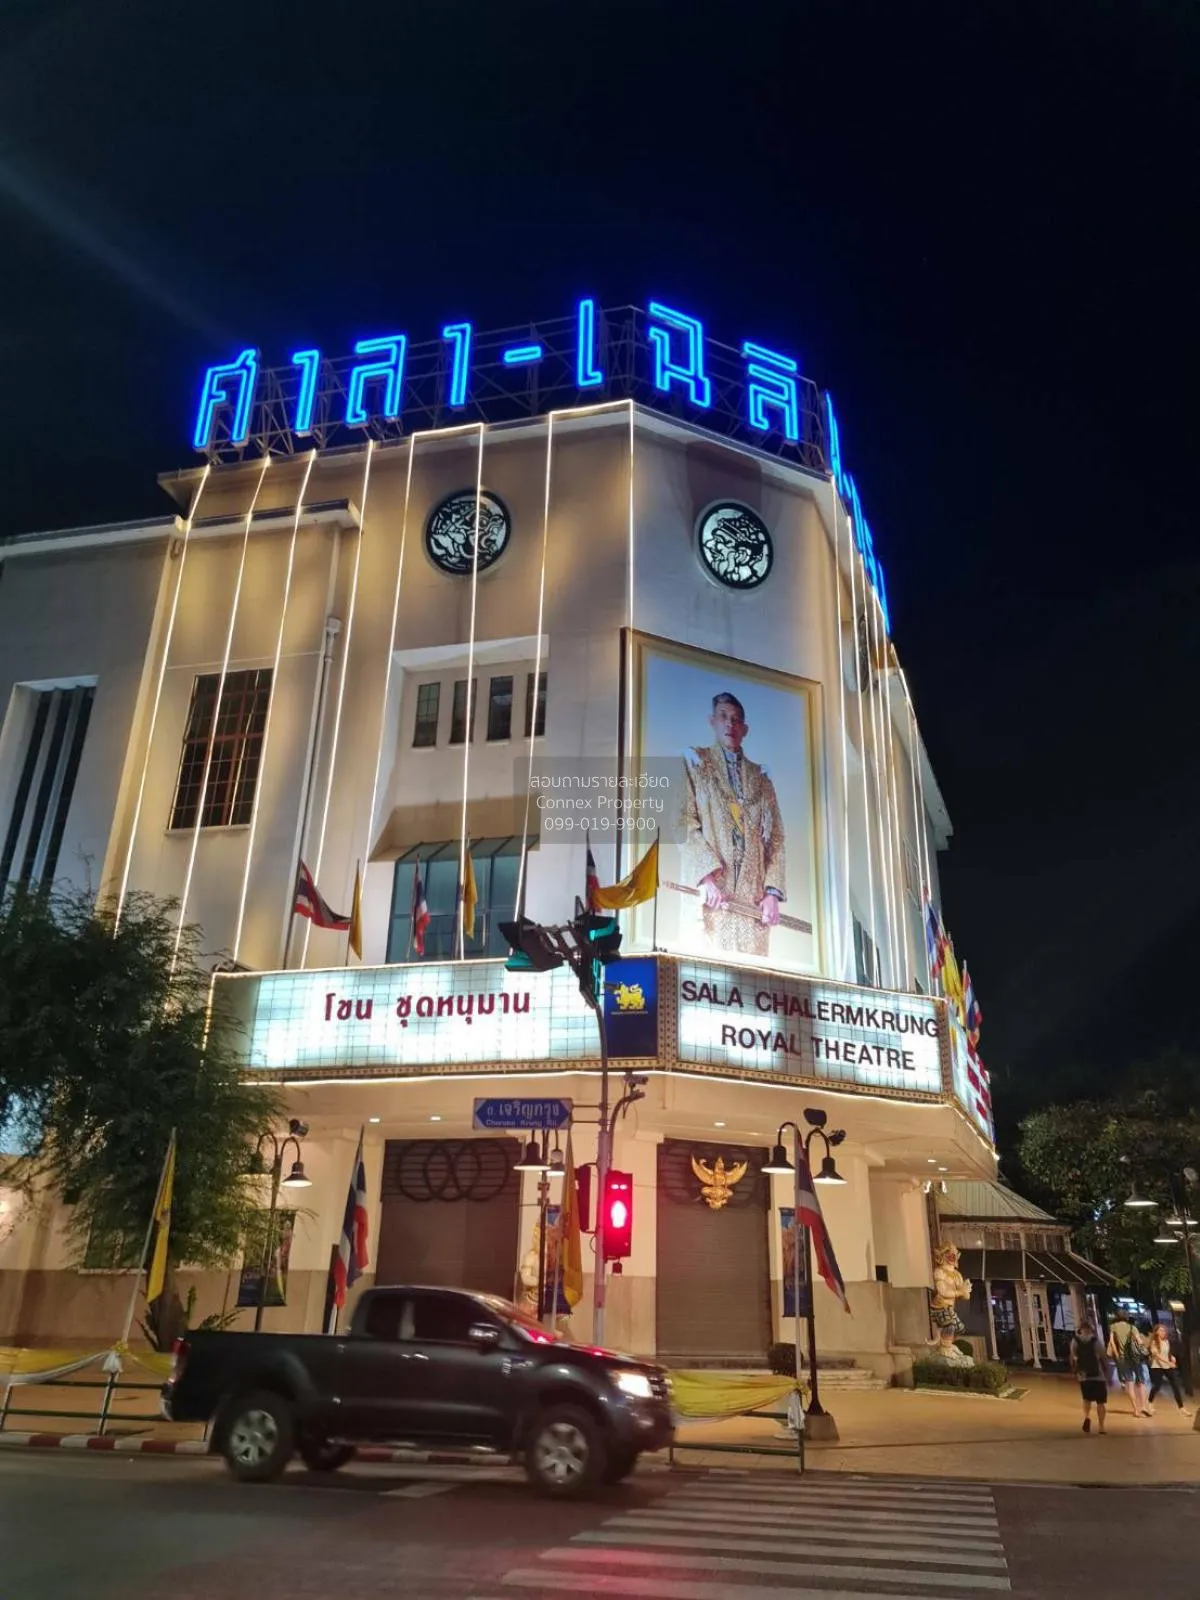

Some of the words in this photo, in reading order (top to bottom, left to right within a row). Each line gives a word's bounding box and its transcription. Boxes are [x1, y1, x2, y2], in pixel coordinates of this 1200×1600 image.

[324, 993, 373, 1021] โขน
[396, 992, 530, 1028] ชุดหนุมาน
[681, 980, 744, 1008] SALA
[754, 991, 939, 1038] CHALERMKRUNG
[721, 1024, 801, 1056] ROYAL
[811, 1036, 916, 1070] THEATRE
